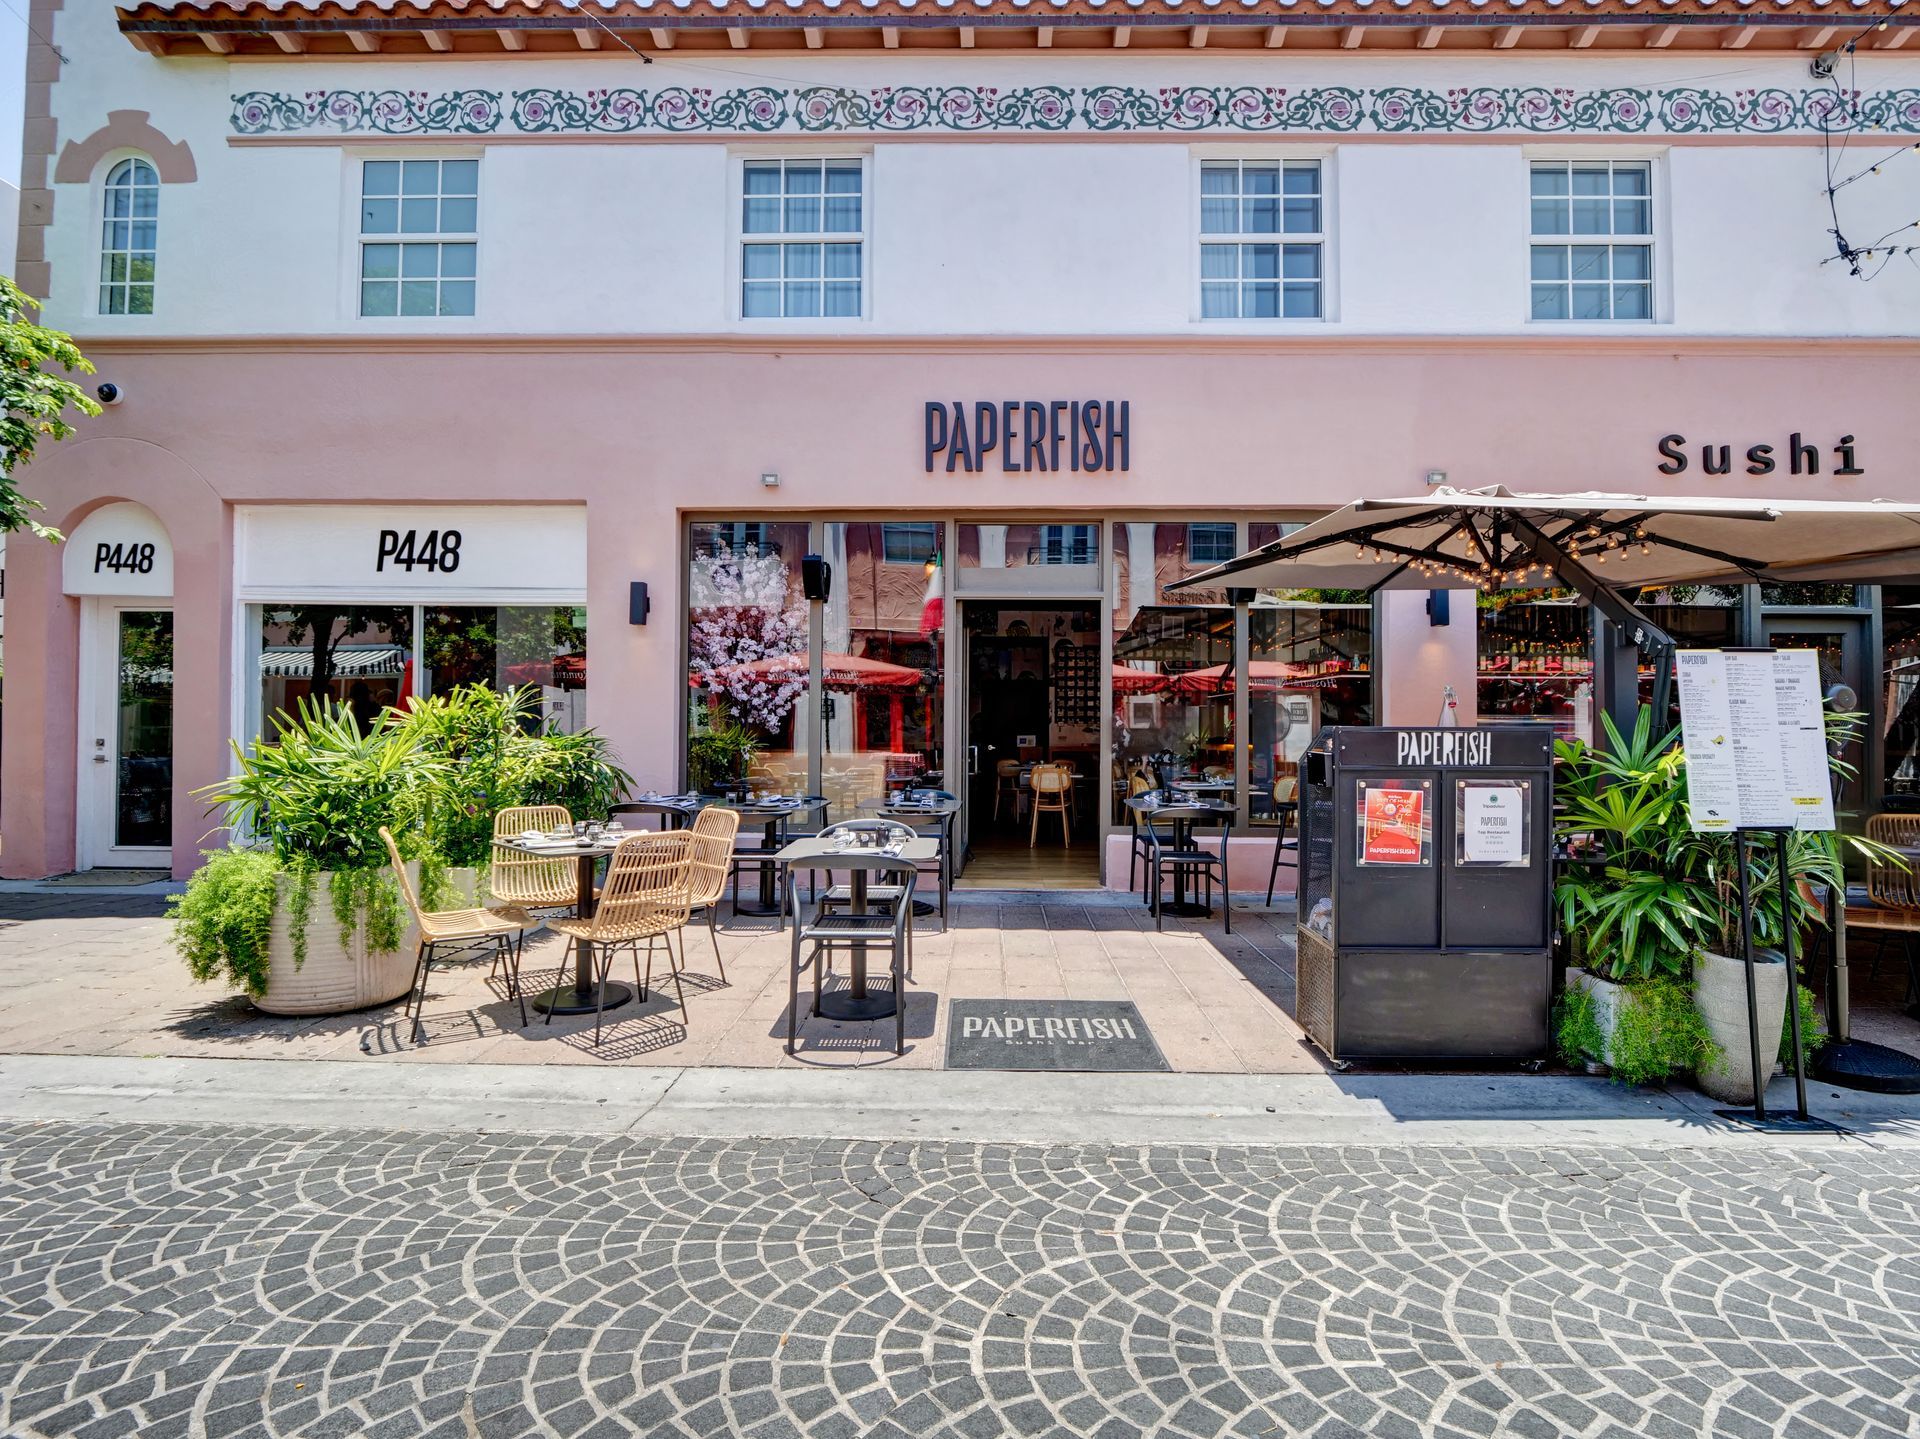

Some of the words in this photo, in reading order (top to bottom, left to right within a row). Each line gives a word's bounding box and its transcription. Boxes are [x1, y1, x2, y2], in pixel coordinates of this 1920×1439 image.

[925, 400, 1129, 472] PAPERFISH
[1657, 432, 1865, 476] Sushi
[94, 542, 156, 574] P448
[376, 529, 462, 573] P448
[1681, 655, 1708, 665] PAPERFISH
[1398, 731, 1491, 766] PAPERFISH
[1480, 816, 1508, 827] PAPERFISH
[963, 1016, 1137, 1040] PAPERFISH
